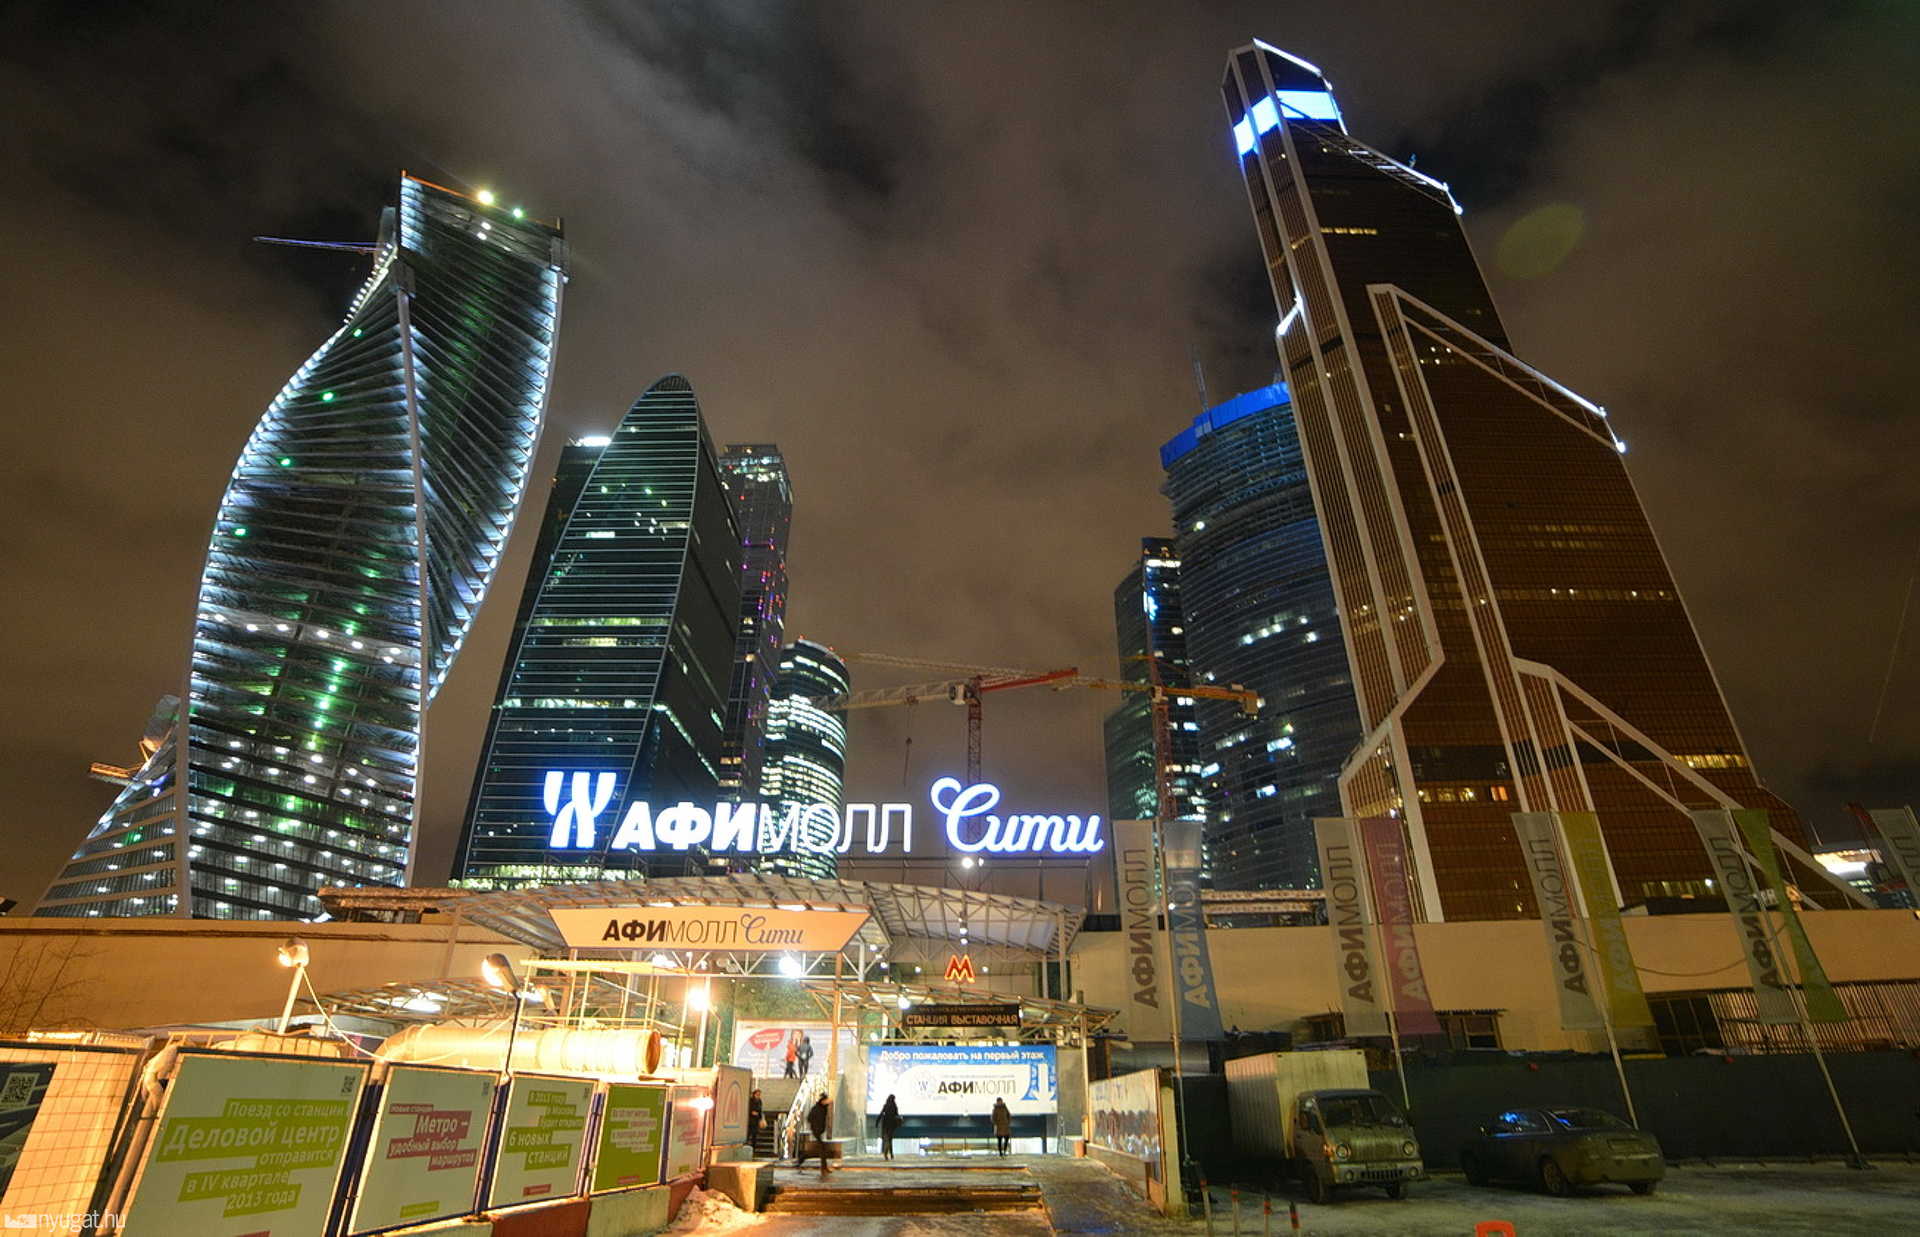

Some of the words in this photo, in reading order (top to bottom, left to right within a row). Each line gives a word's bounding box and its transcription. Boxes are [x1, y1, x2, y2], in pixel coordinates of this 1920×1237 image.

[612, 801, 911, 854] АФИМОЛЛ
[930, 777, 1104, 853] Сити
[1327, 845, 1375, 1003] АФИМОЛЛ
[1528, 839, 1587, 995] АФИМОЛЛ
[602, 919, 737, 944] АФИМОЛЛ
[740, 913, 804, 944] Сити
[1124, 849, 1159, 1009] АФИМОЛЛ
[906, 1015, 948, 1025] СТАНЦИЯ
[951, 1014, 1018, 1025] ВЫСТАВОЧНАЯ
[880, 1050, 911, 1061] Добро
[912, 1051, 969, 1061] пожаловать
[971, 1052, 982, 1060] на
[985, 1050, 1020, 1061] первый
[1021, 1051, 1044, 1060] этаж
[938, 1080, 1016, 1094] АФИМОЛЛ
[228, 1102, 271, 1117] Поезд
[275, 1105, 289, 1116] со
[416, 1115, 458, 1137] Метро
[163, 1121, 277, 1156] Деловой
[280, 1125, 340, 1149] центр
[259, 1150, 333, 1169] отправится
[187, 1179, 196, 1193] в
[201, 1176, 218, 1191] IV
[222, 1171, 289, 1193] квартале
[227, 1194, 263, 1210] 2013
[266, 1190, 296, 1206] года
